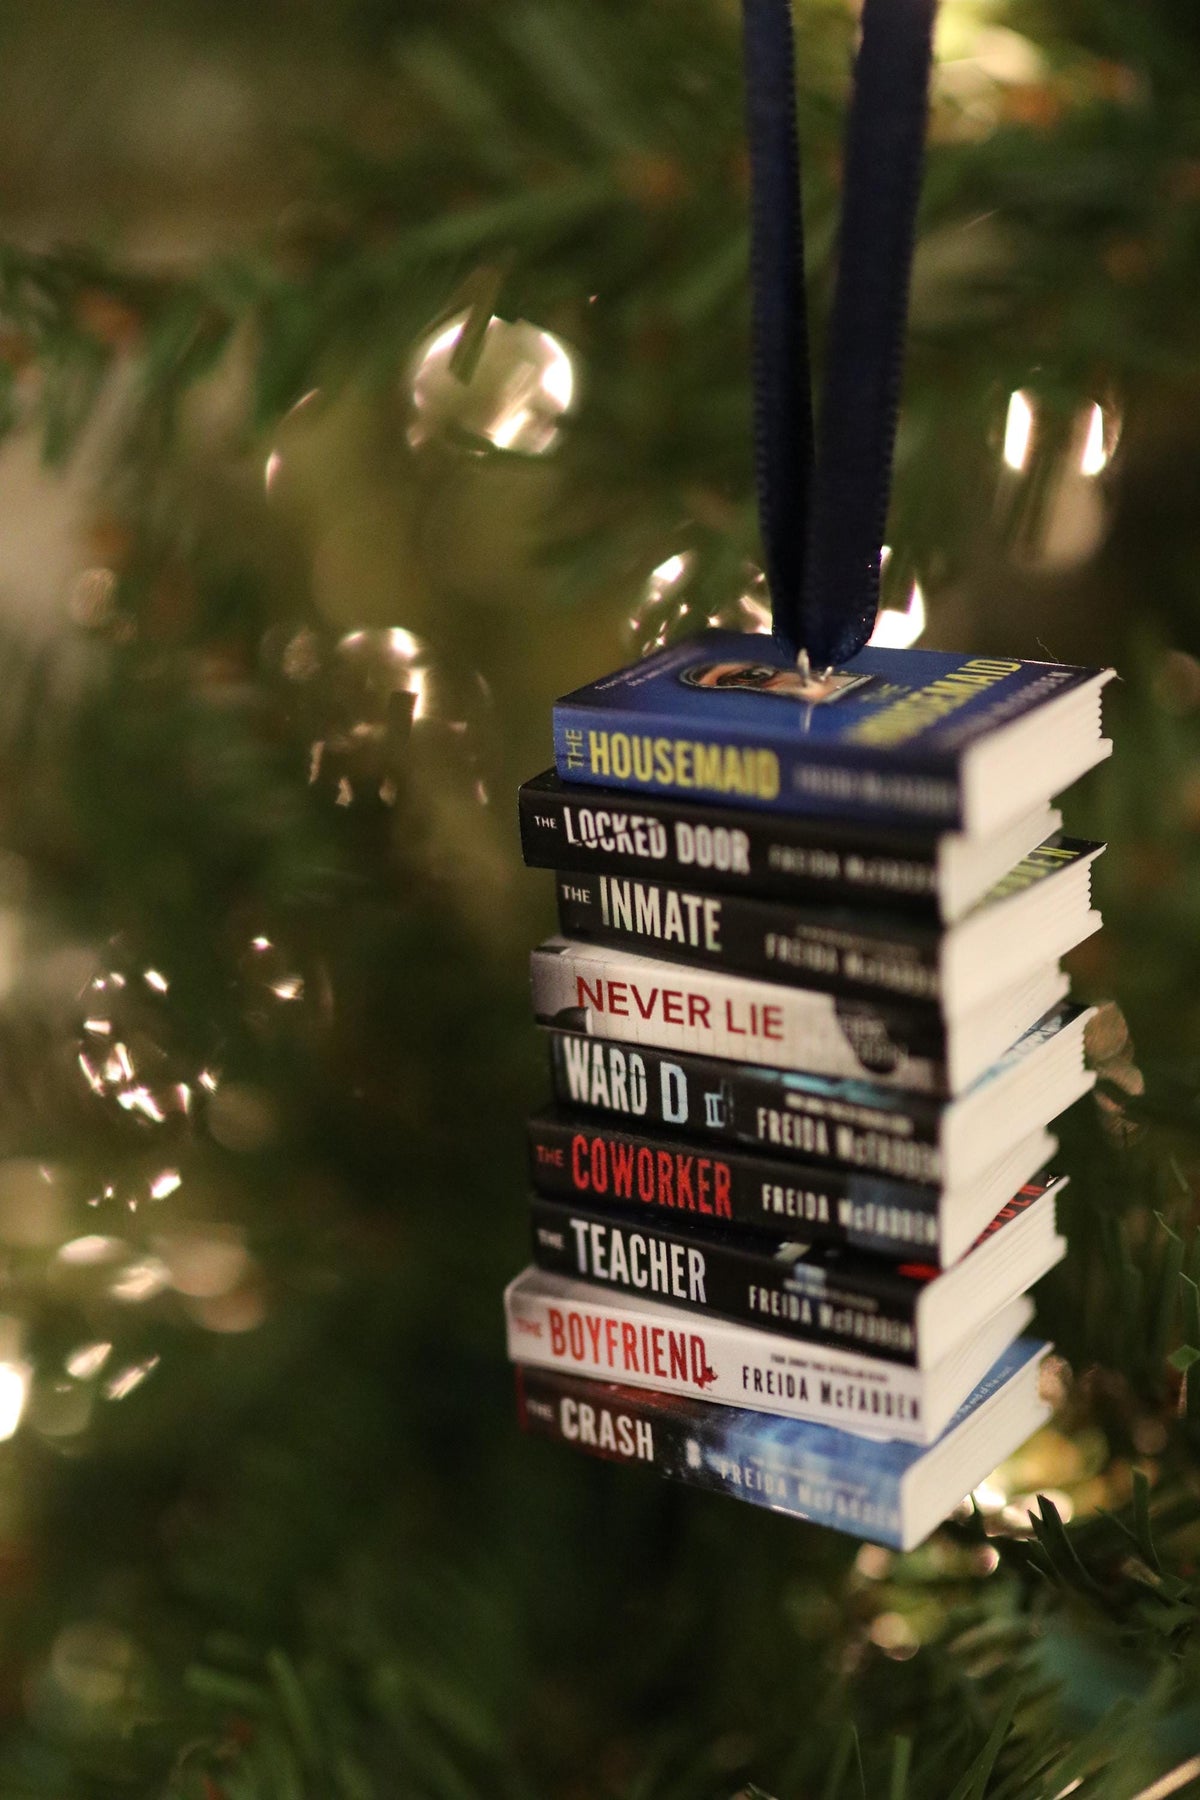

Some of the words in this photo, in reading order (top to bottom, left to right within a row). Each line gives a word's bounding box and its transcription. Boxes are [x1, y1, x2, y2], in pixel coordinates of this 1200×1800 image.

[565, 728, 584, 770] THE
[589, 730, 780, 800] HOUSEMAID
[534, 815, 557, 829] THE
[563, 806, 667, 859] LOCKED
[675, 821, 750, 875] DOOR
[561, 884, 591, 904] THE
[600, 876, 722, 951] INMATE
[576, 976, 711, 1029] NEVER
[726, 998, 783, 1040] LIE
[563, 1036, 648, 1115] WARD
[660, 1060, 689, 1124] D
[757, 1107, 829, 1156] FREIDA
[536, 1145, 564, 1167] THE
[571, 1134, 732, 1220] COWORKER
[762, 1183, 830, 1223] FREIDA
[570, 1218, 706, 1303] TEACHER
[749, 1284, 812, 1326] FREIDA
[547, 1308, 713, 1387] BOYFRIEND
[742, 1365, 809, 1402] FREIDA
[560, 1397, 654, 1462] CRASH
[720, 1456, 788, 1499] FREIDA
